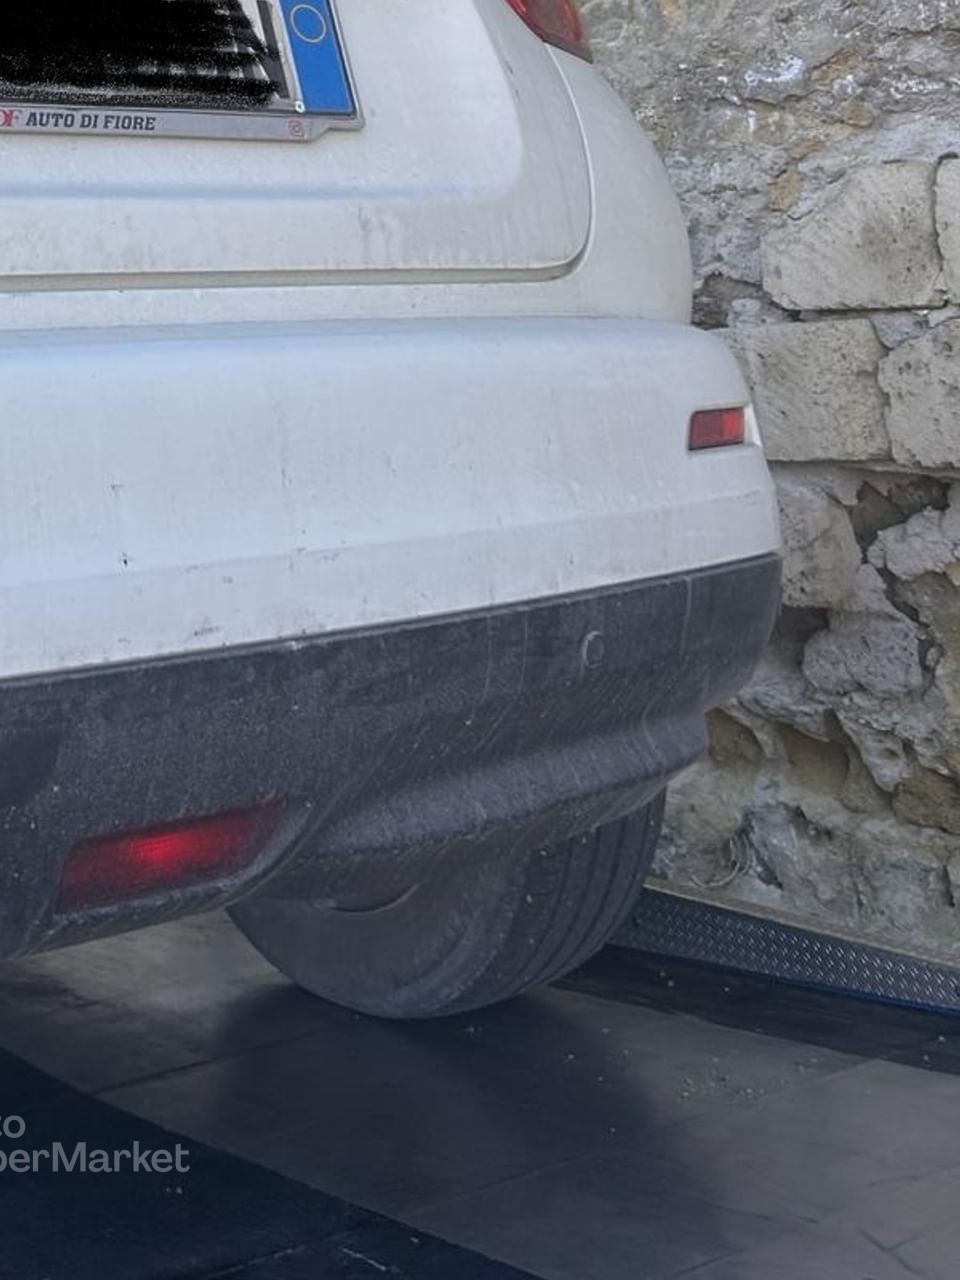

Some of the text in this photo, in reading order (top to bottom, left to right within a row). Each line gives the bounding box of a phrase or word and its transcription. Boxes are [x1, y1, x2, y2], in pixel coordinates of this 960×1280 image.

[26, 111, 75, 128] AUTO
[79, 114, 99, 128] DI
[103, 115, 157, 131] FIORE
